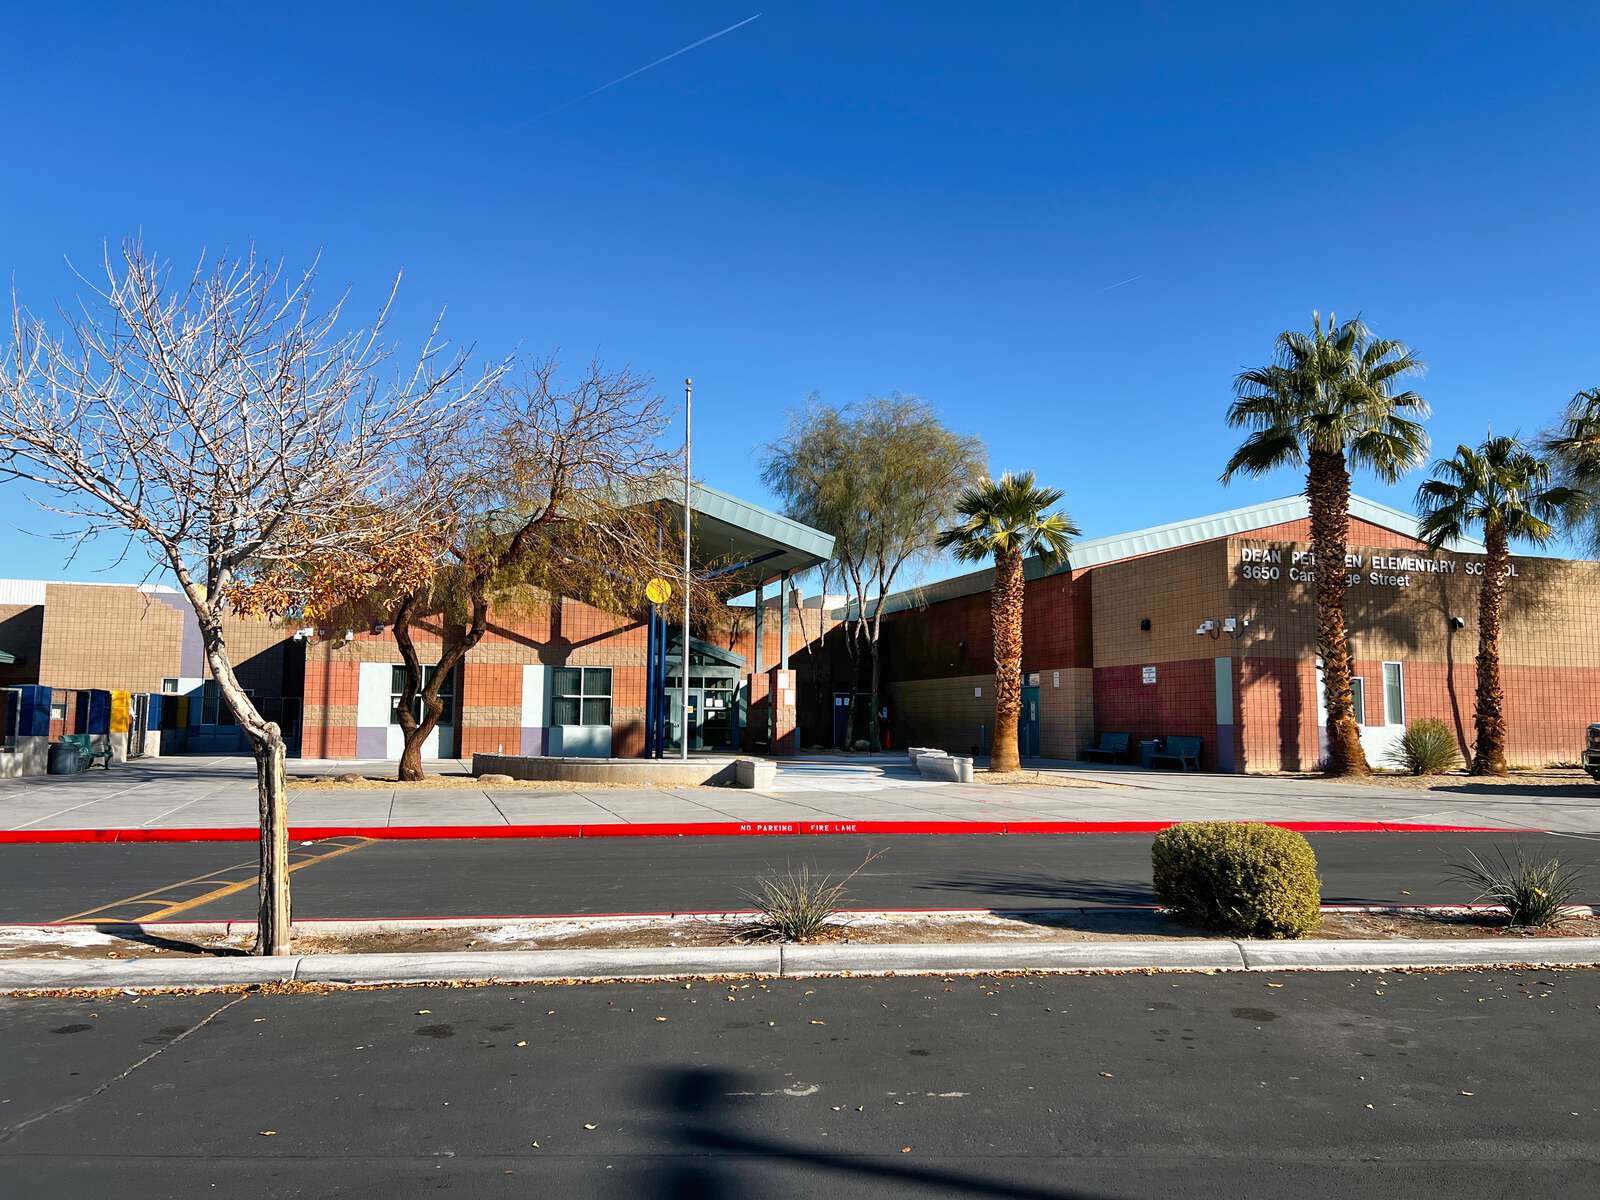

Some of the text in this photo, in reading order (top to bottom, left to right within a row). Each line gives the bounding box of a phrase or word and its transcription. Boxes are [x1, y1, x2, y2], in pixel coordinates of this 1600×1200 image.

[1242, 548, 1519, 577] DEAN PETEN ELEMENTARY SCOL
[1242, 565, 1280, 580] 3650
[1369, 572, 1410, 587] Street
